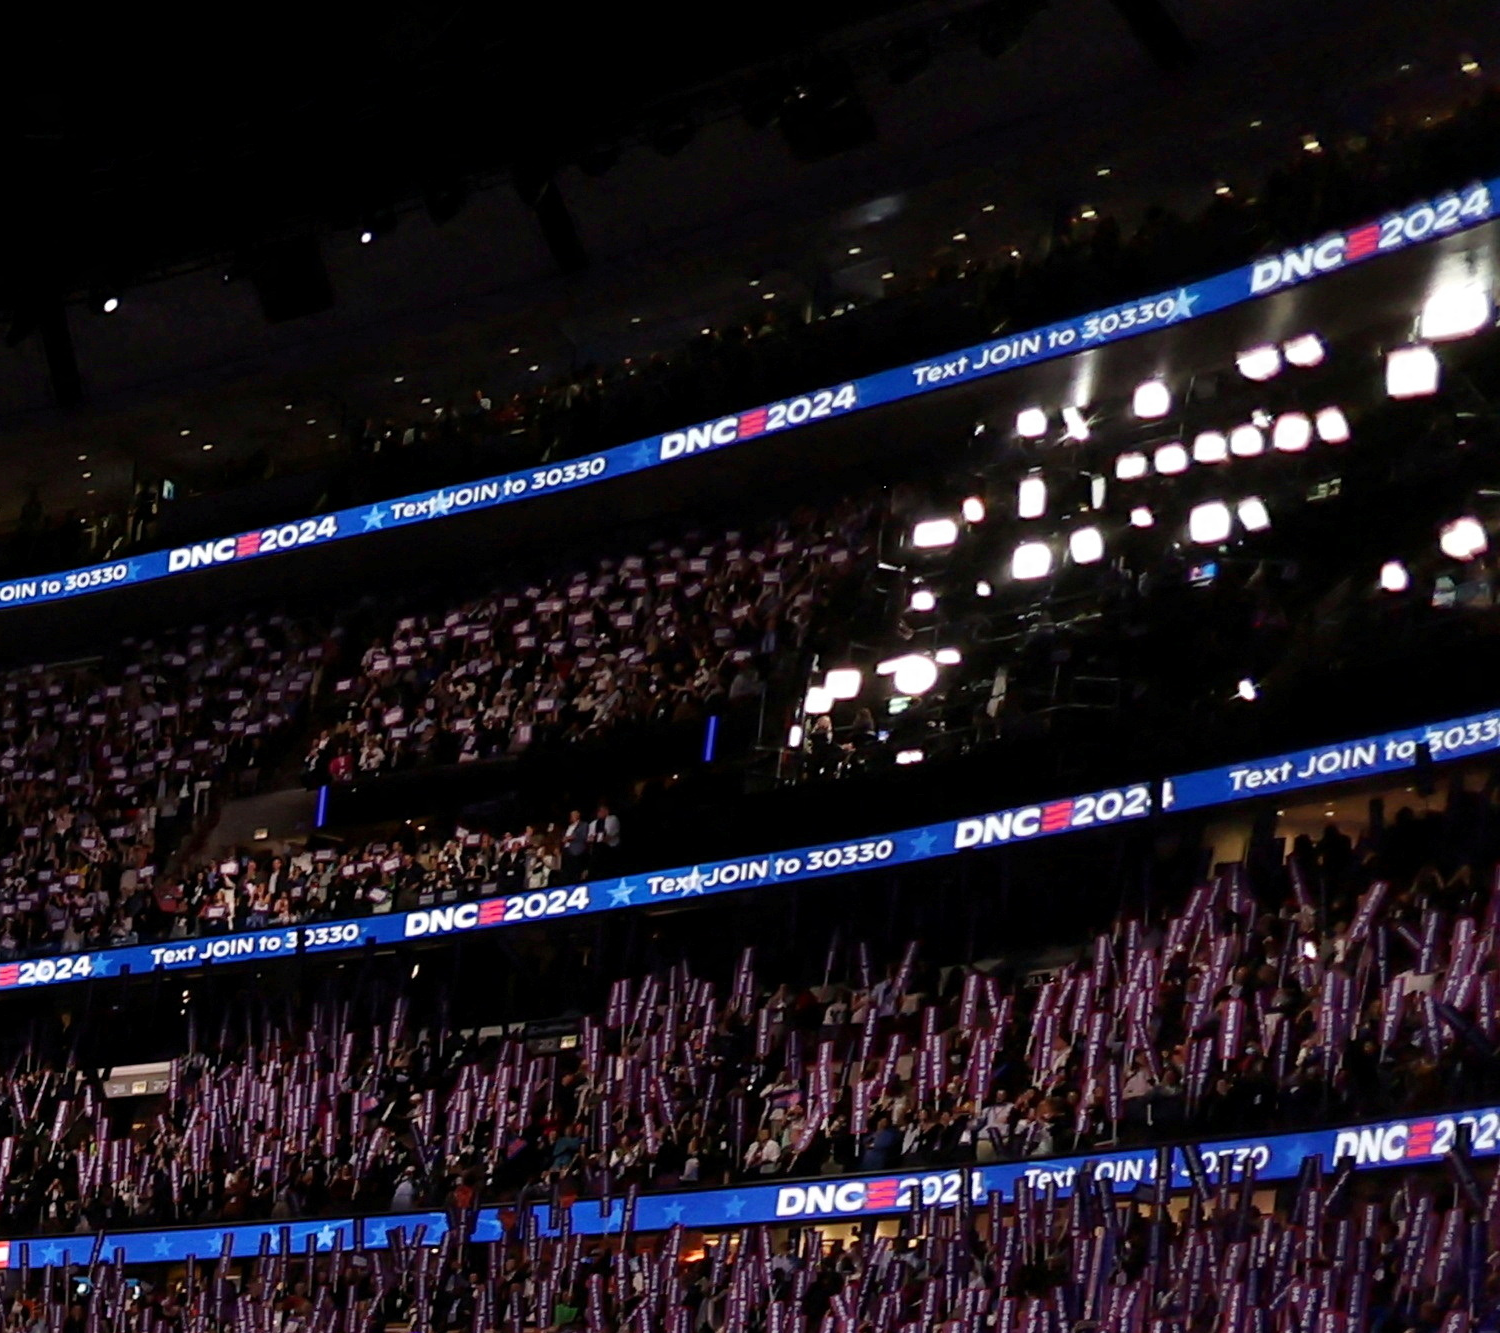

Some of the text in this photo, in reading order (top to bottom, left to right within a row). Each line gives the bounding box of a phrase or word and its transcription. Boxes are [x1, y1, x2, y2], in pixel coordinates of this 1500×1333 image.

[913, 298, 1174, 384] Text JOIN to 30330
[42, 581, 60, 594] to
[65, 565, 126, 590] 30330
